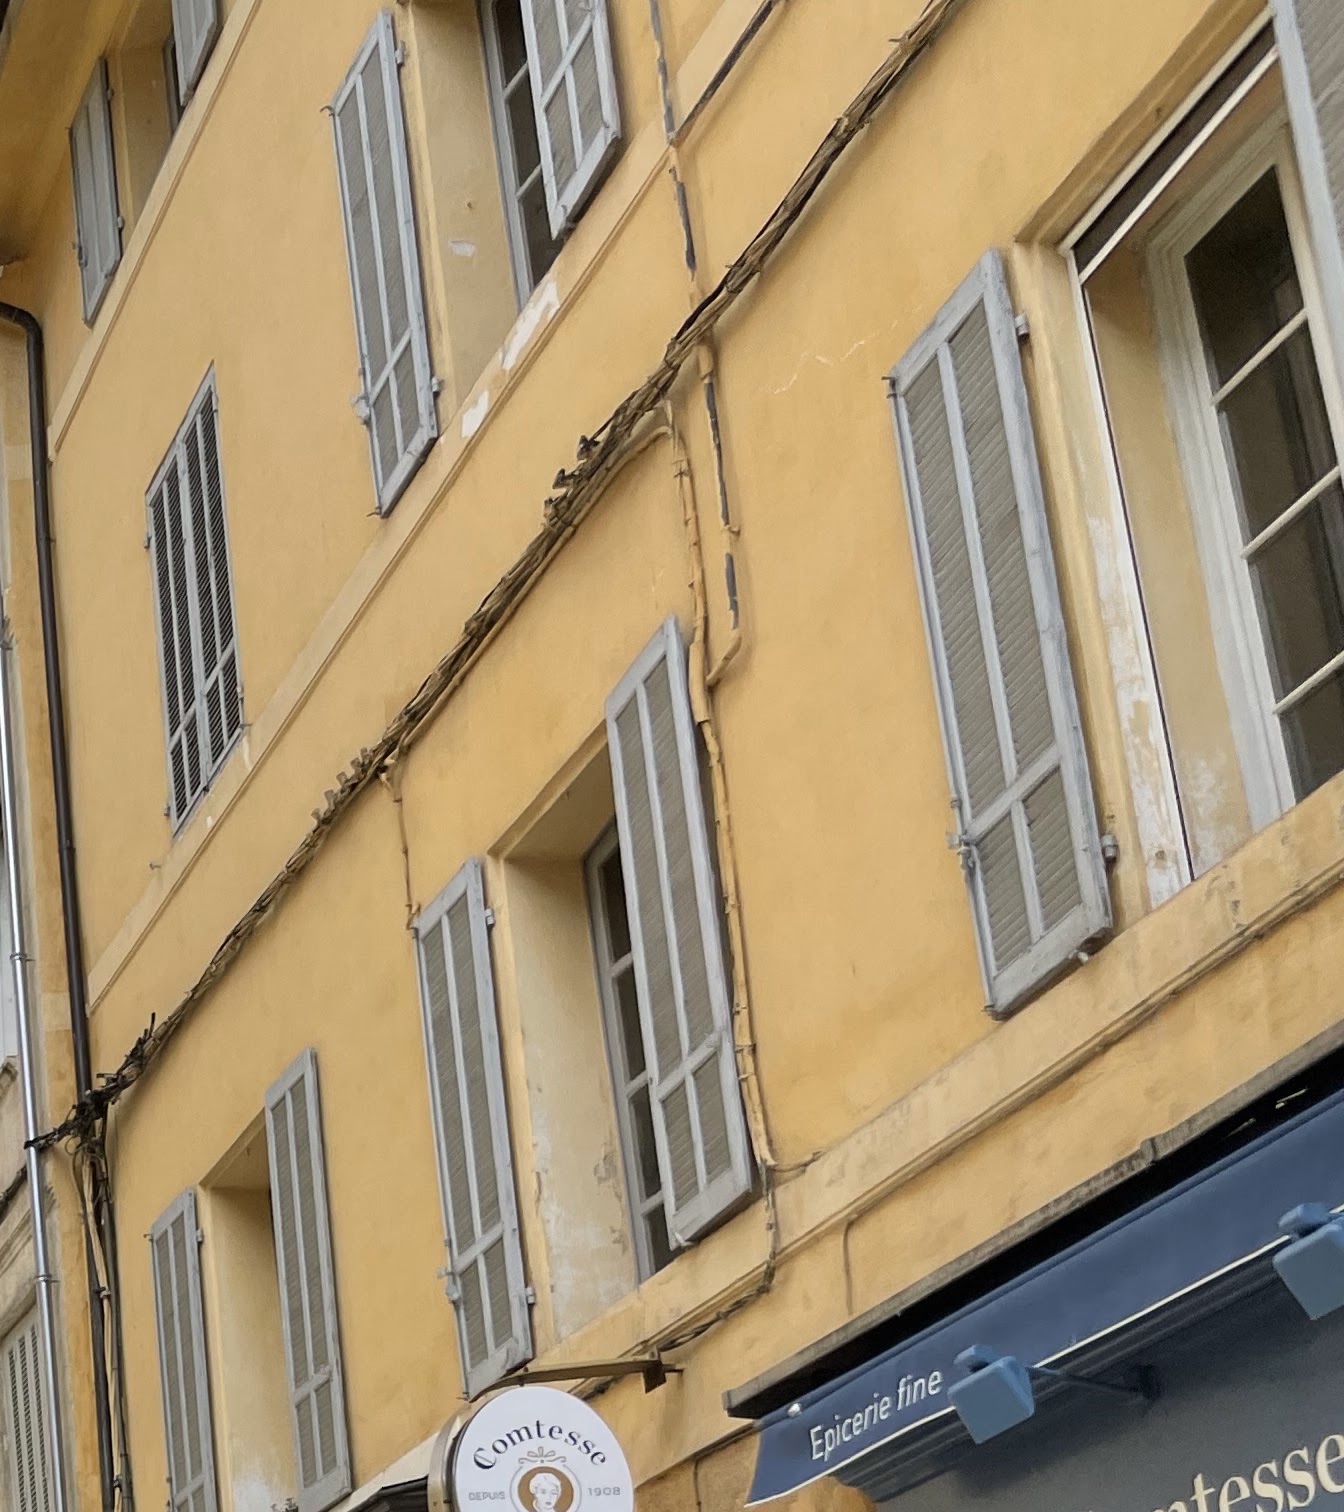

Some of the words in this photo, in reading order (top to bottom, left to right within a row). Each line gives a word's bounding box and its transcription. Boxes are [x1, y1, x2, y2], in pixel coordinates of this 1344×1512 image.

[809, 1393, 892, 1462] Epicerie
[896, 1369, 944, 1411] fine
[473, 1420, 607, 1470] Comtesse
[468, 1491, 506, 1501] DEPUIS
[587, 1486, 621, 1497] 1908
